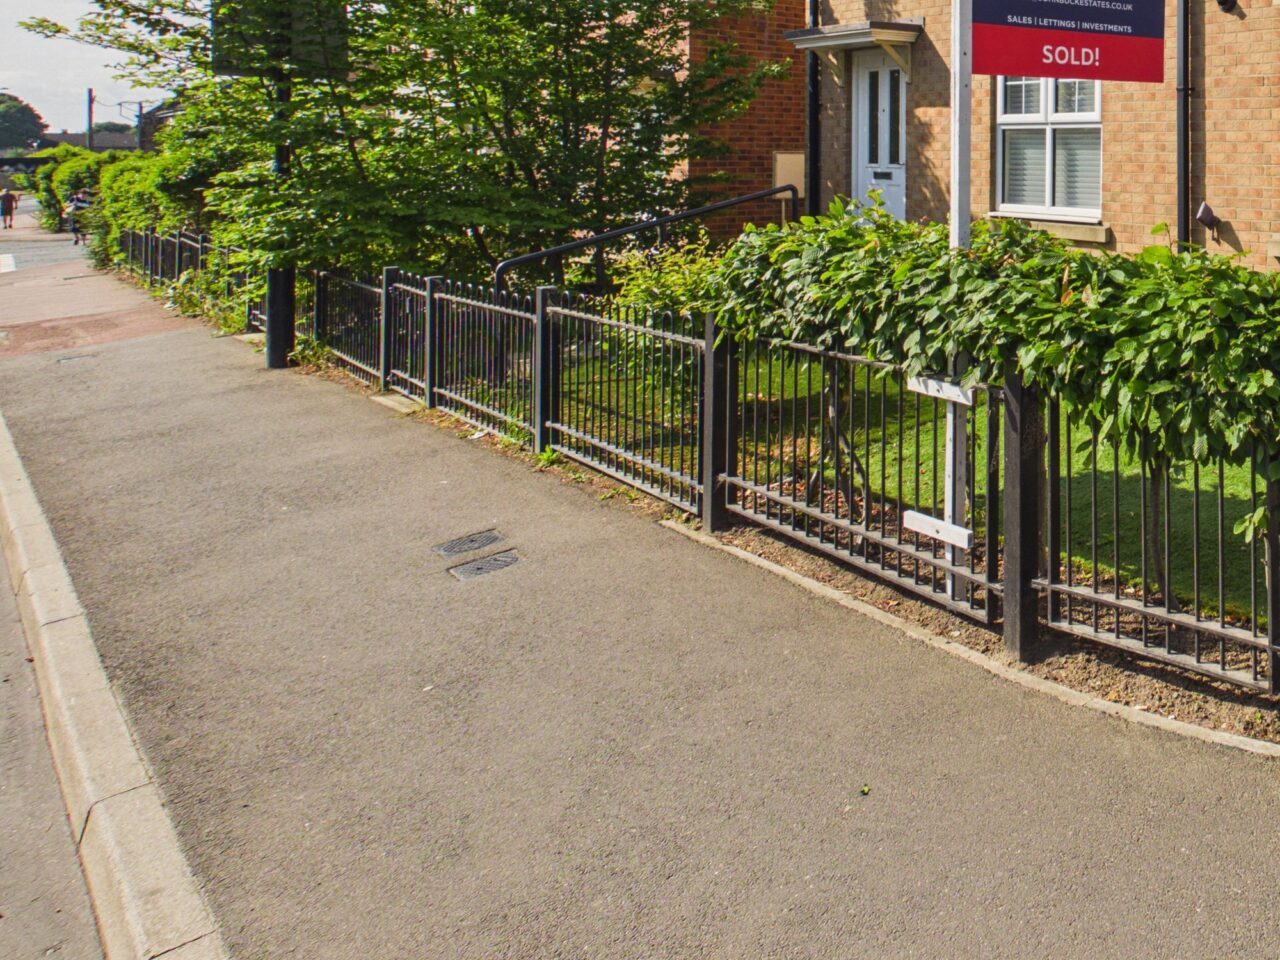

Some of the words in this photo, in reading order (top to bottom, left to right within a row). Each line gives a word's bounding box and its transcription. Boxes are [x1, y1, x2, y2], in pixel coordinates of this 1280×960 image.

[1007, 15, 1032, 25] SALES
[1039, 18, 1076, 29] LETTINGS
[1082, 22, 1132, 32] INVESTMENTS
[1042, 44, 1100, 66] SOLD!
